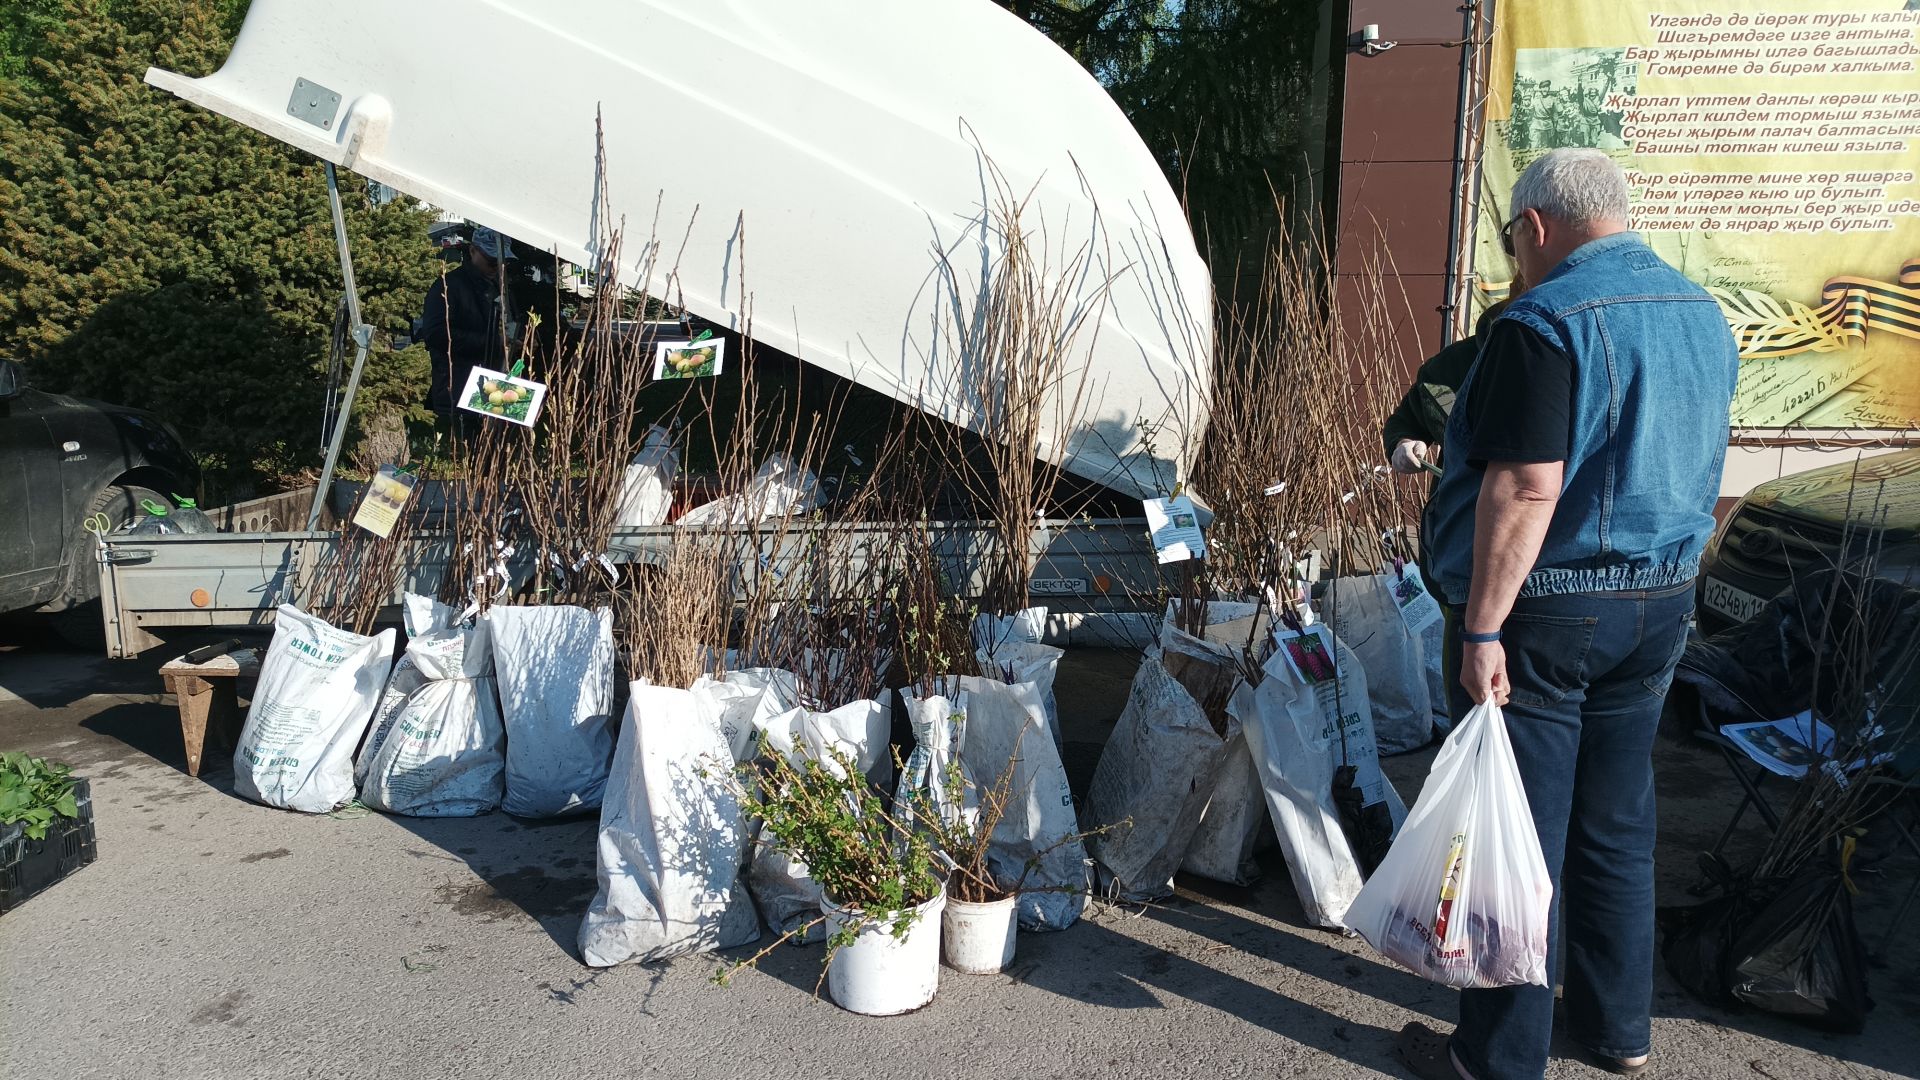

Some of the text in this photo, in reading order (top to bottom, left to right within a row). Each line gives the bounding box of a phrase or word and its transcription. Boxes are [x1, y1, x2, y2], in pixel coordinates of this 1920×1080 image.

[1649, 13, 1722, 27] Үлгәндә
[1727, 12, 1749, 26] дә
[1754, 12, 1809, 28] йөрәк
[1812, 12, 1866, 27] туры
[1657, 28, 1914, 45] Шигъремдәге изге антына.
[1625, 47, 1659, 62] Бар
[1663, 47, 1761, 61] җырымны
[1765, 46, 1808, 58] илгә
[1646, 60, 1915, 78] Гомремне дә бирәм халкыма.
[1605, 92, 1920, 110] Җырлап үттем данлы көрәш кыр
[1623, 109, 1920, 125] Җырлап килдем тормыш языма
[1623, 126, 1682, 140] Соңгы
[1685, 126, 1756, 140] җырым
[1760, 127, 1813, 137] палач
[1634, 140, 1908, 154] Башны тоткан килеш языла.
[1624, 172, 1914, 187] Җыр өйрәтте мине хөр яшәргә
[1643, 186, 1886, 202] һәм үләргә кыю ир булып.
[1673, 204, 1733, 215] минем
[1737, 204, 1800, 217] моңлы
[1803, 202, 1837, 217] бер
[1840, 203, 1883, 216] җыр
[1630, 216, 1894, 233] Үлемем дә яңрар җыр булып.
[1033, 580, 1081, 589] ВЕКТОР
[290, 637, 324, 660] TOWER
[269, 756, 299, 768] GREEN
